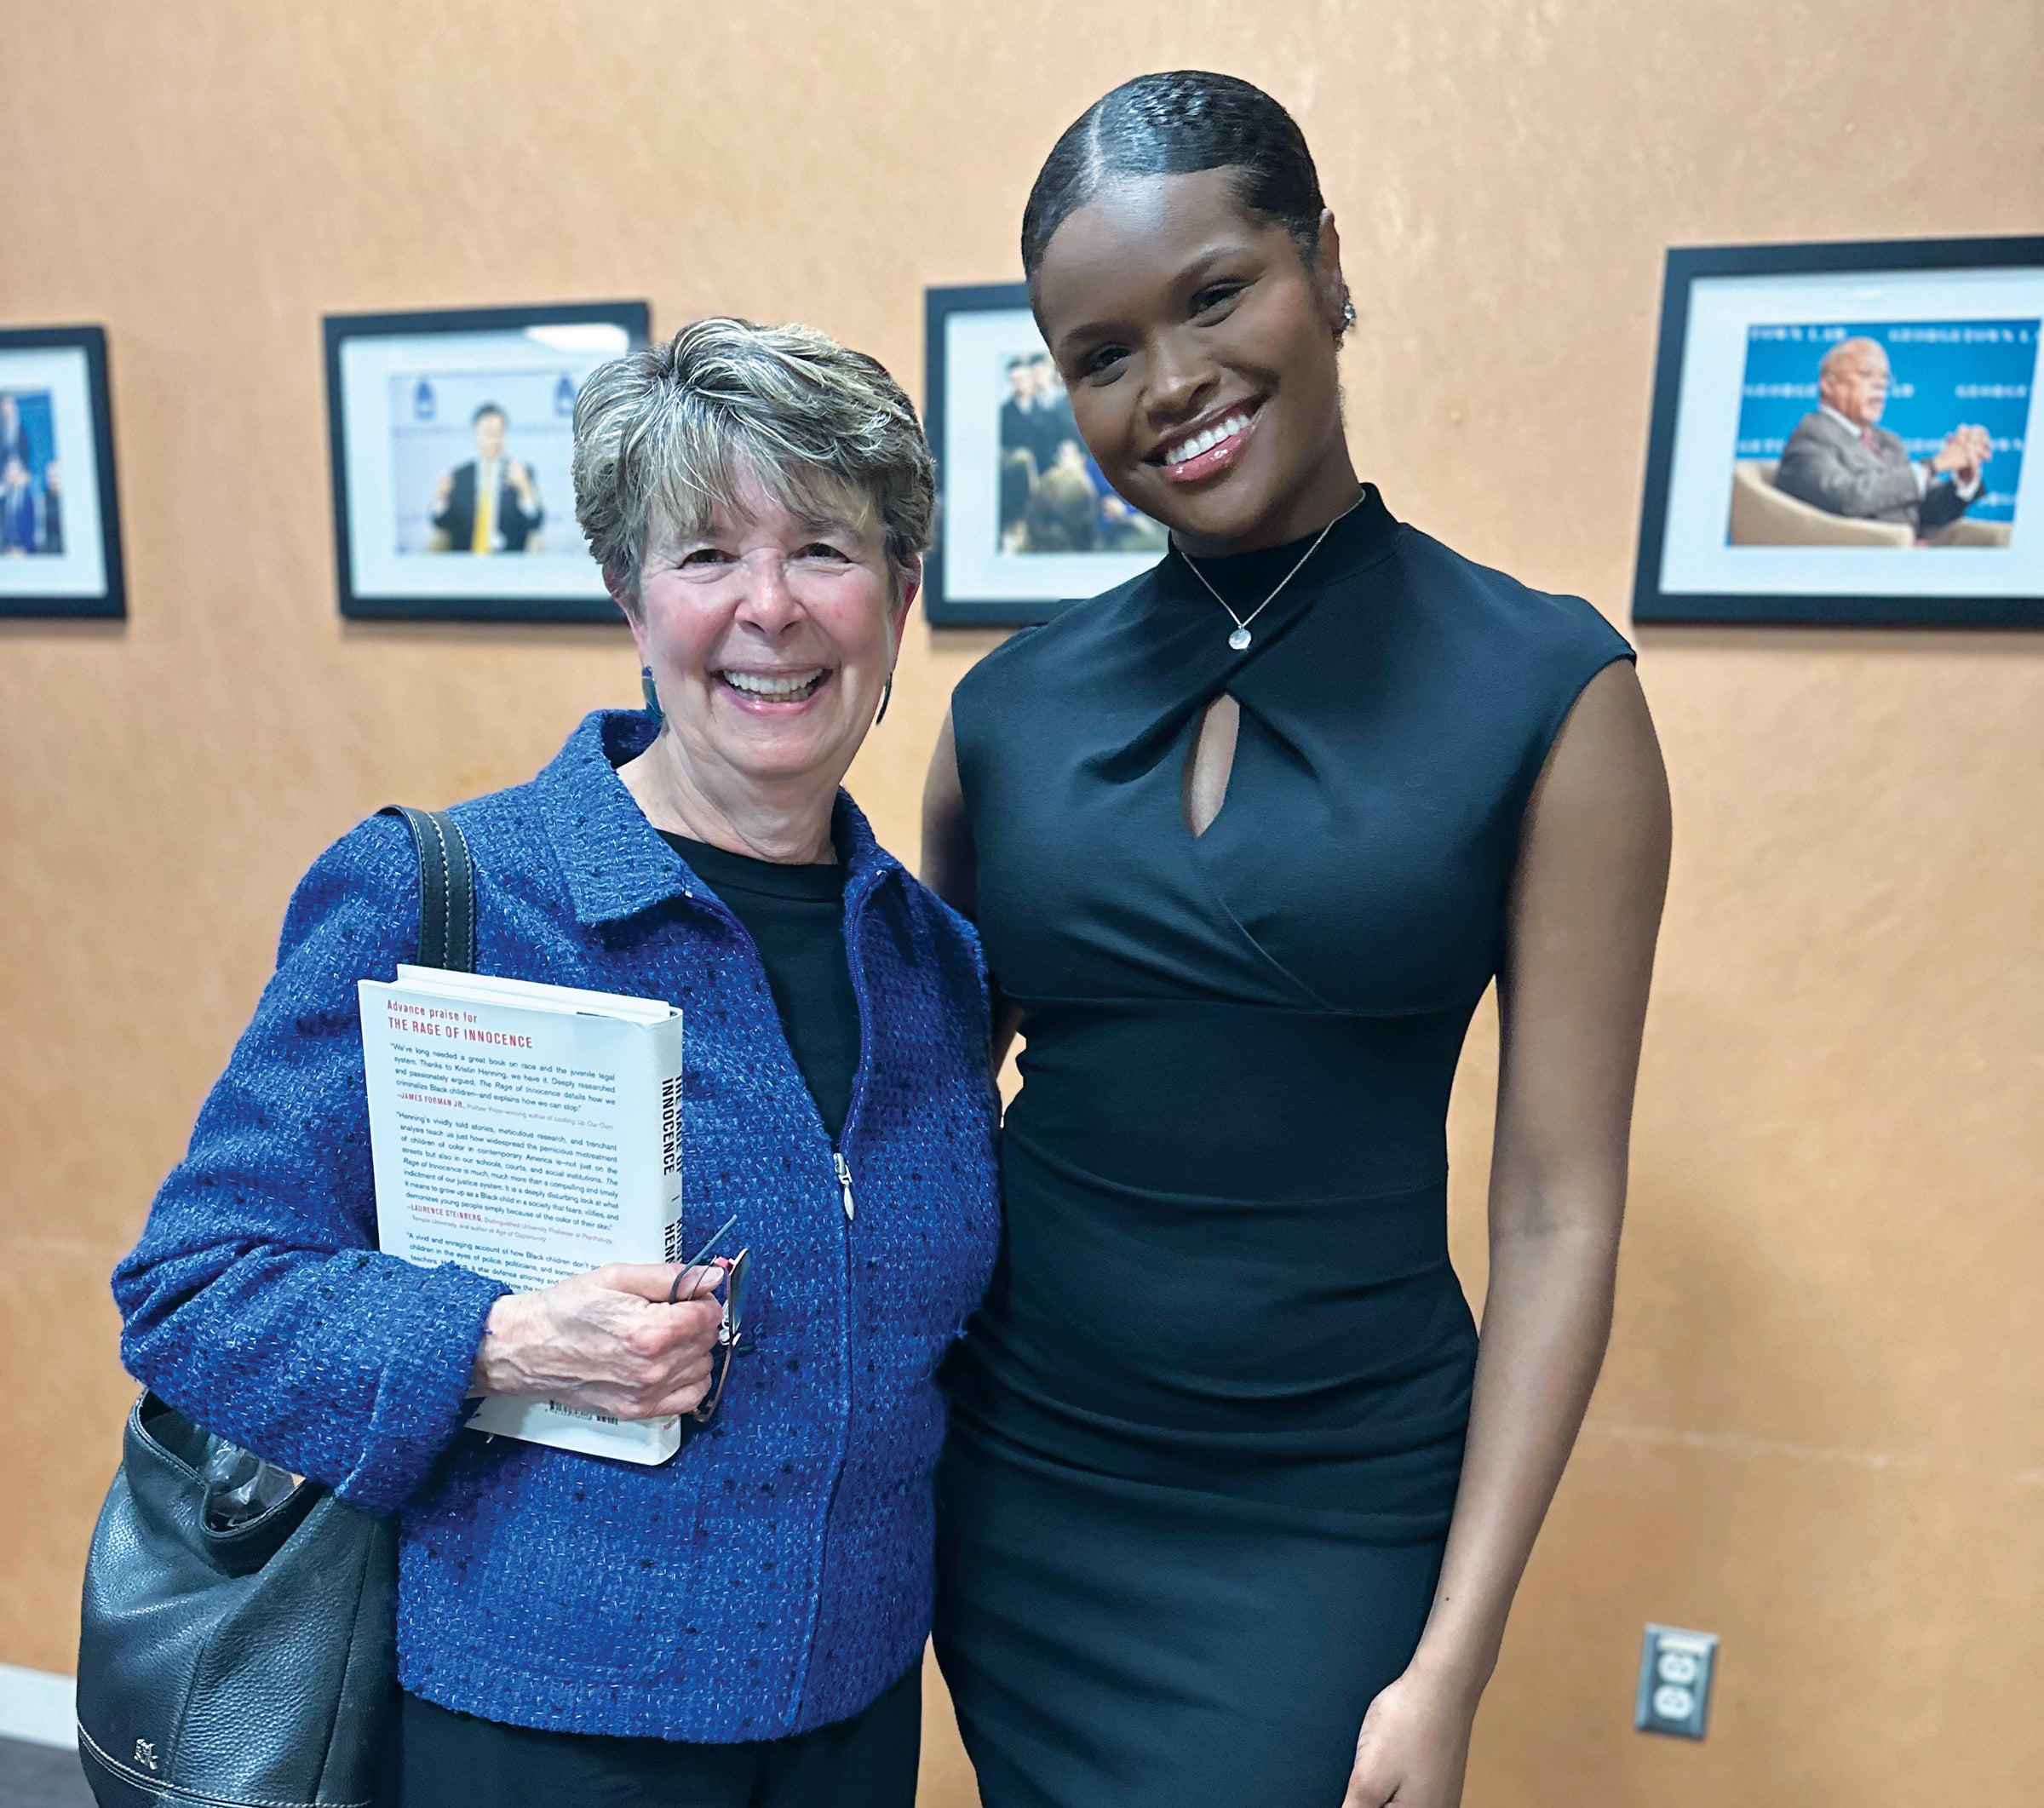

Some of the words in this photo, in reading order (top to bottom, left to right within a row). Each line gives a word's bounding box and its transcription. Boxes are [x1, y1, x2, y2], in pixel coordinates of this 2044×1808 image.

[388, 1000, 425, 1016] Advance
[429, 1008, 459, 1021] praise
[463, 1012, 477, 1024] for
[388, 1017, 408, 1031] THE
[412, 1020, 441, 1036] RAGE
[445, 1025, 459, 1039] OF
[464, 1029, 532, 1048] INNOCENCE
[415, 1047, 430, 1058] long
[433, 1051, 457, 1060] needed
[488, 1057, 506, 1066] book
[570, 1070, 596, 1078] juvenile
[599, 1072, 615, 1082] legal
[419, 1059, 443, 1070] Thanks
[454, 1065, 476, 1074] Kristin
[523, 1074, 540, 1083] have
[551, 1077, 575, 1089] Deeply
[577, 1082, 616, 1093] researched
[396, 1079, 428, 1090] criminalize
[429, 1083, 448, 1093] Black
[493, 1094, 520, 1104] explains
[521, 1097, 537, 1105] how
[409, 1070, 449, 1083] passionately
[479, 1079, 492, 1088] The
[495, 1082, 513, 1092] Rage
[525, 1086, 561, 1097] Innocence
[563, 1092, 586, 1101] details
[588, 1094, 603, 1103] how
[424, 1095, 452, 1107] FORMAN
[400, 1124, 424, 1134] analysis
[469, 1134, 485, 1142] how
[485, 1138, 525, 1149] widespread
[526, 1142, 537, 1151] the
[539, 1145, 573, 1156] pernicious
[575, 1151, 617, 1163] mistreatment
[433, 1118, 453, 1128] vividly
[498, 1128, 534, 1139] meticulous
[586, 1140, 617, 1151] trenchant
[662, 1078, 675, 1176] INNOCENCE
[402, 1147, 423, 1157] streets
[425, 1150, 436, 1158] but
[438, 1152, 452, 1161] also
[606, 1178, 618, 1186] The
[410, 1137, 435, 1146] children
[448, 1143, 465, 1151] color
[477, 1148, 523, 1161] contemporary
[525, 1154, 553, 1164] America
[403, 1157, 420, 1168] Rage
[428, 1162, 462, 1174] Innocence
[549, 1182, 585, 1194] compelling
[600, 1189, 618, 1199] timely
[404, 1168, 436, 1180] indictment
[456, 1179, 479, 1187] justice
[524, 1188, 545, 1199] deeply
[547, 1191, 579, 1204] disturbing
[580, 1197, 594, 1205] look
[603, 1201, 618, 1209] what
[405, 1191, 439, 1203] demonizes
[440, 1199, 460, 1208] young
[461, 1202, 483, 1210] people
[484, 1205, 505, 1214] simply
[506, 1207, 534, 1218] because
[581, 1220, 595, 1228] their
[410, 1182, 430, 1191] means
[480, 1191, 498, 1201] Black
[528, 1201, 551, 1211] society
[445, 1240, 473, 1250] enraging
[474, 1244, 500, 1254] account
[510, 1248, 524, 1257] how
[525, 1251, 544, 1260] Black
[545, 1255, 571, 1265] children
